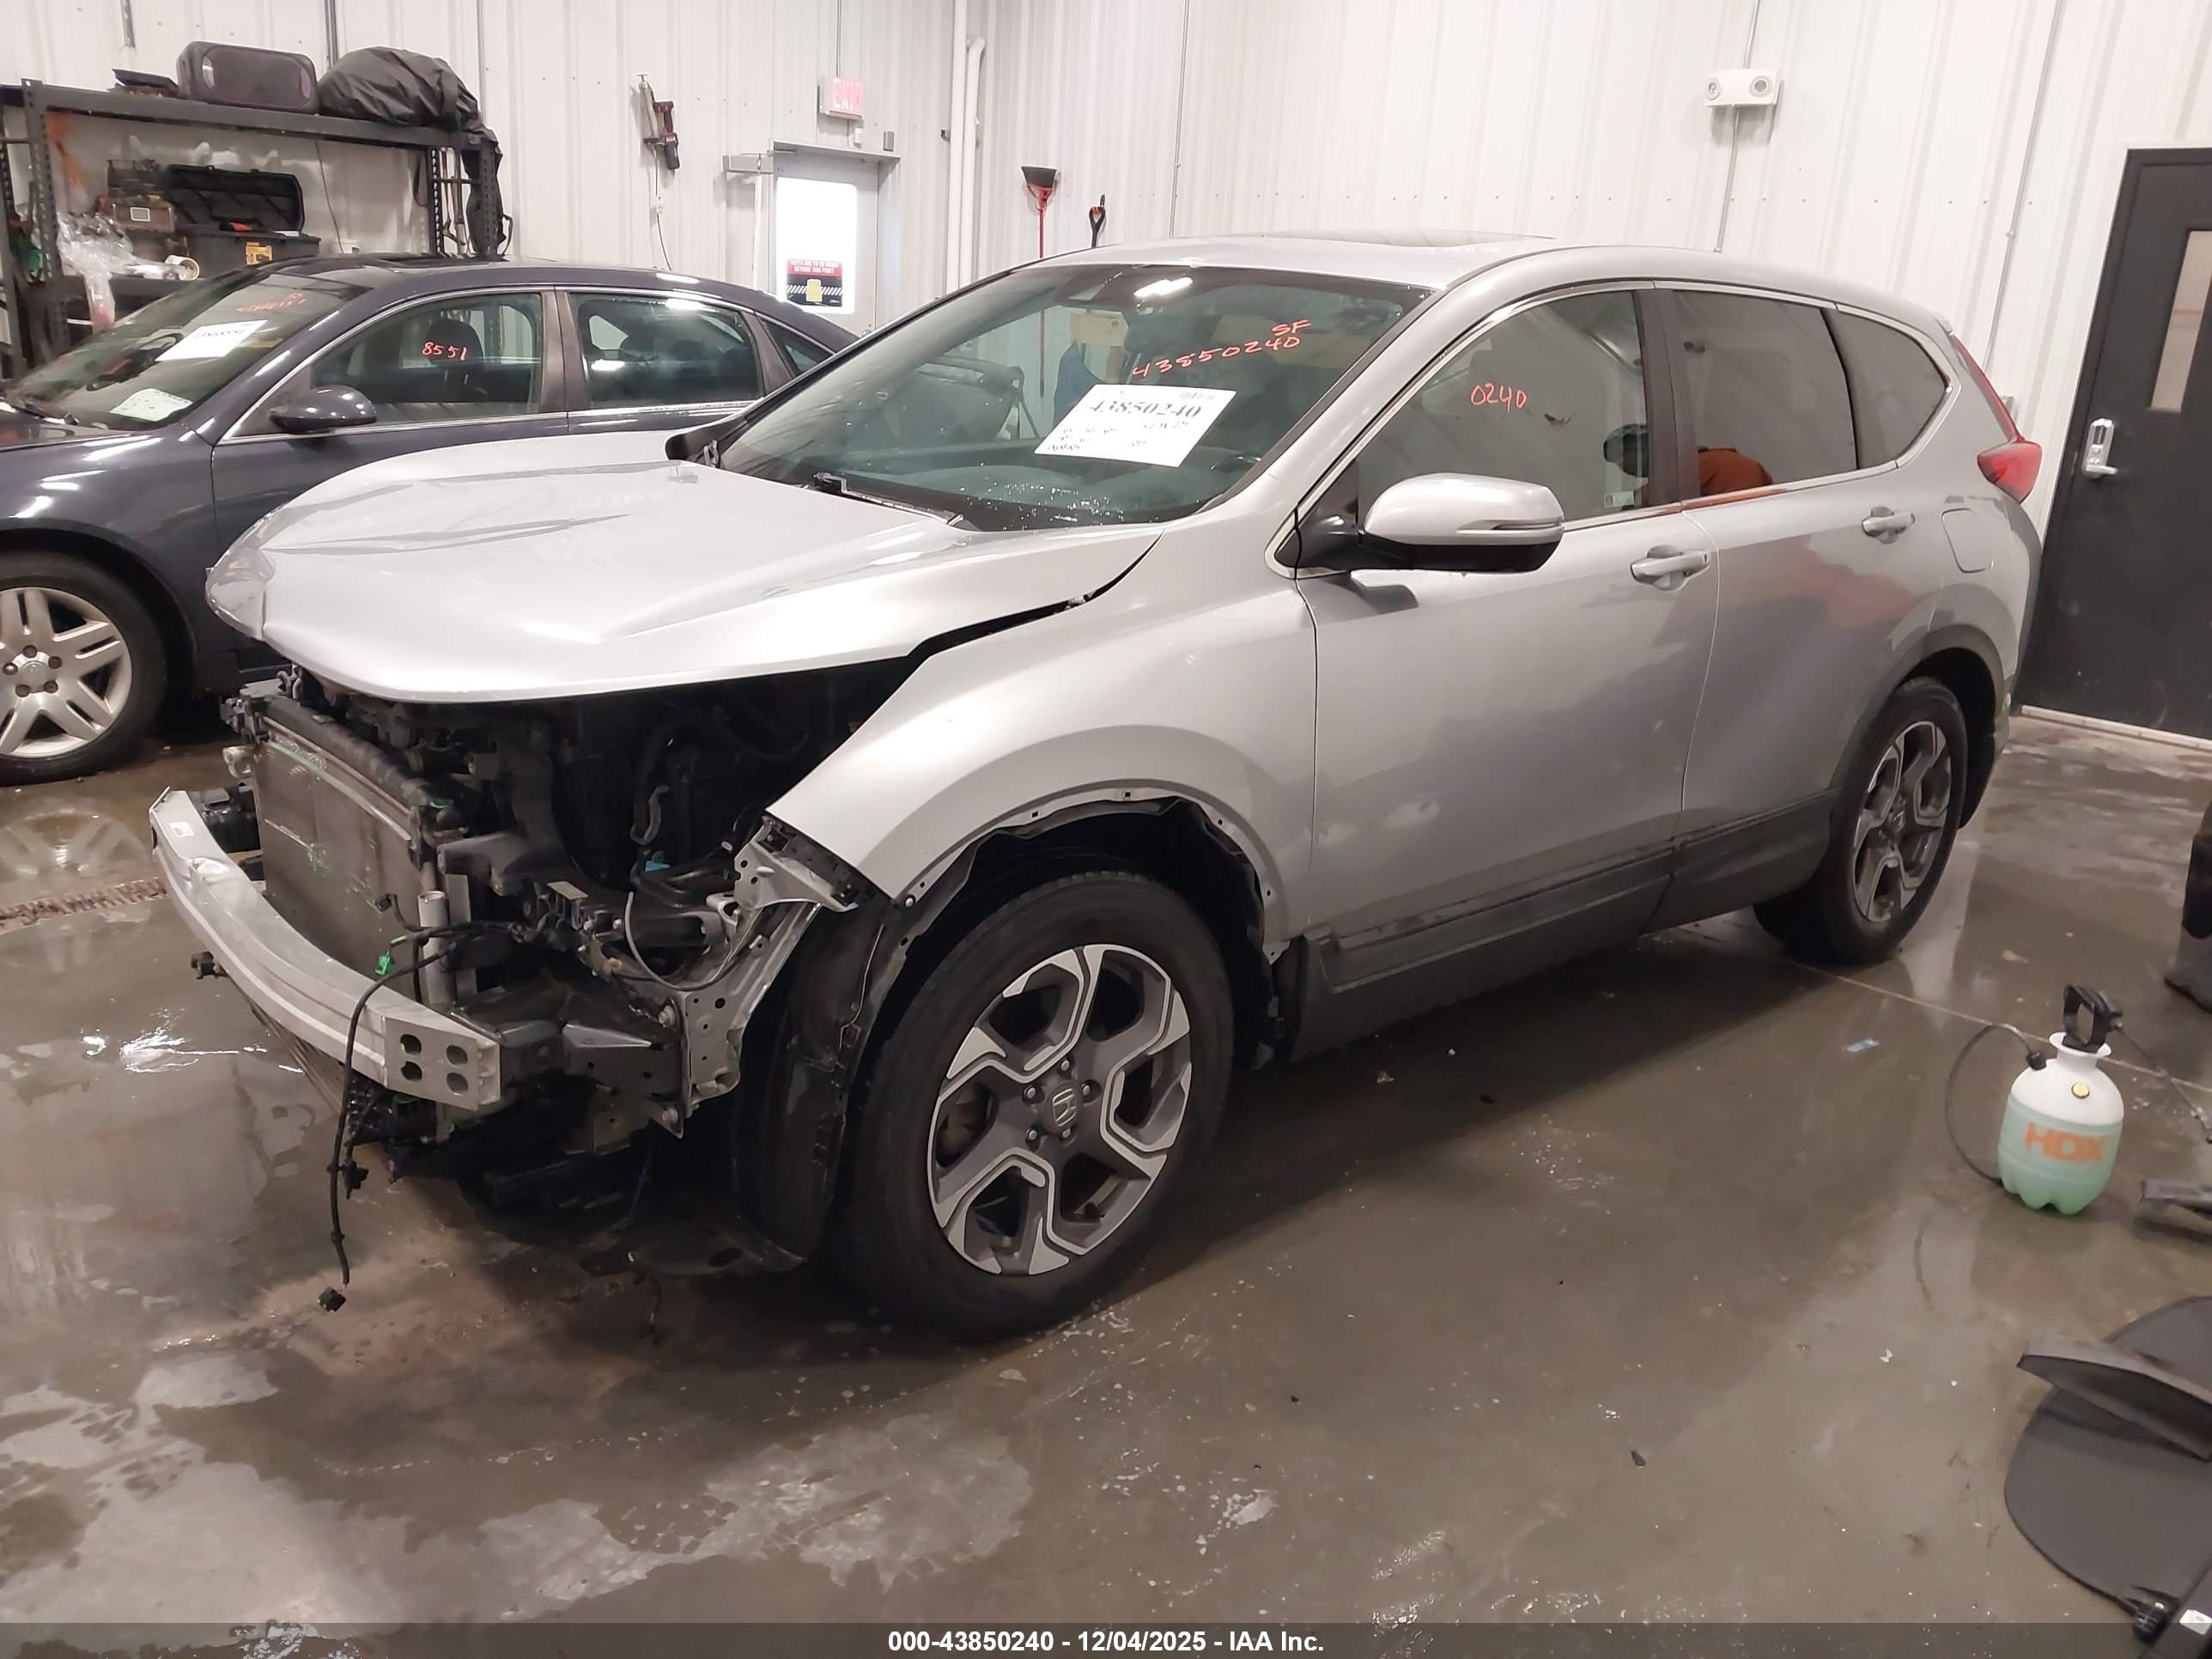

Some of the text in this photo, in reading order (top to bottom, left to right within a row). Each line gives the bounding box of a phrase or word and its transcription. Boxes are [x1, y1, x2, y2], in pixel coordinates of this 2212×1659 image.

[1271, 319, 1312, 337] SF
[1132, 336, 1302, 378] 43850240
[1470, 382, 1528, 413] 0240
